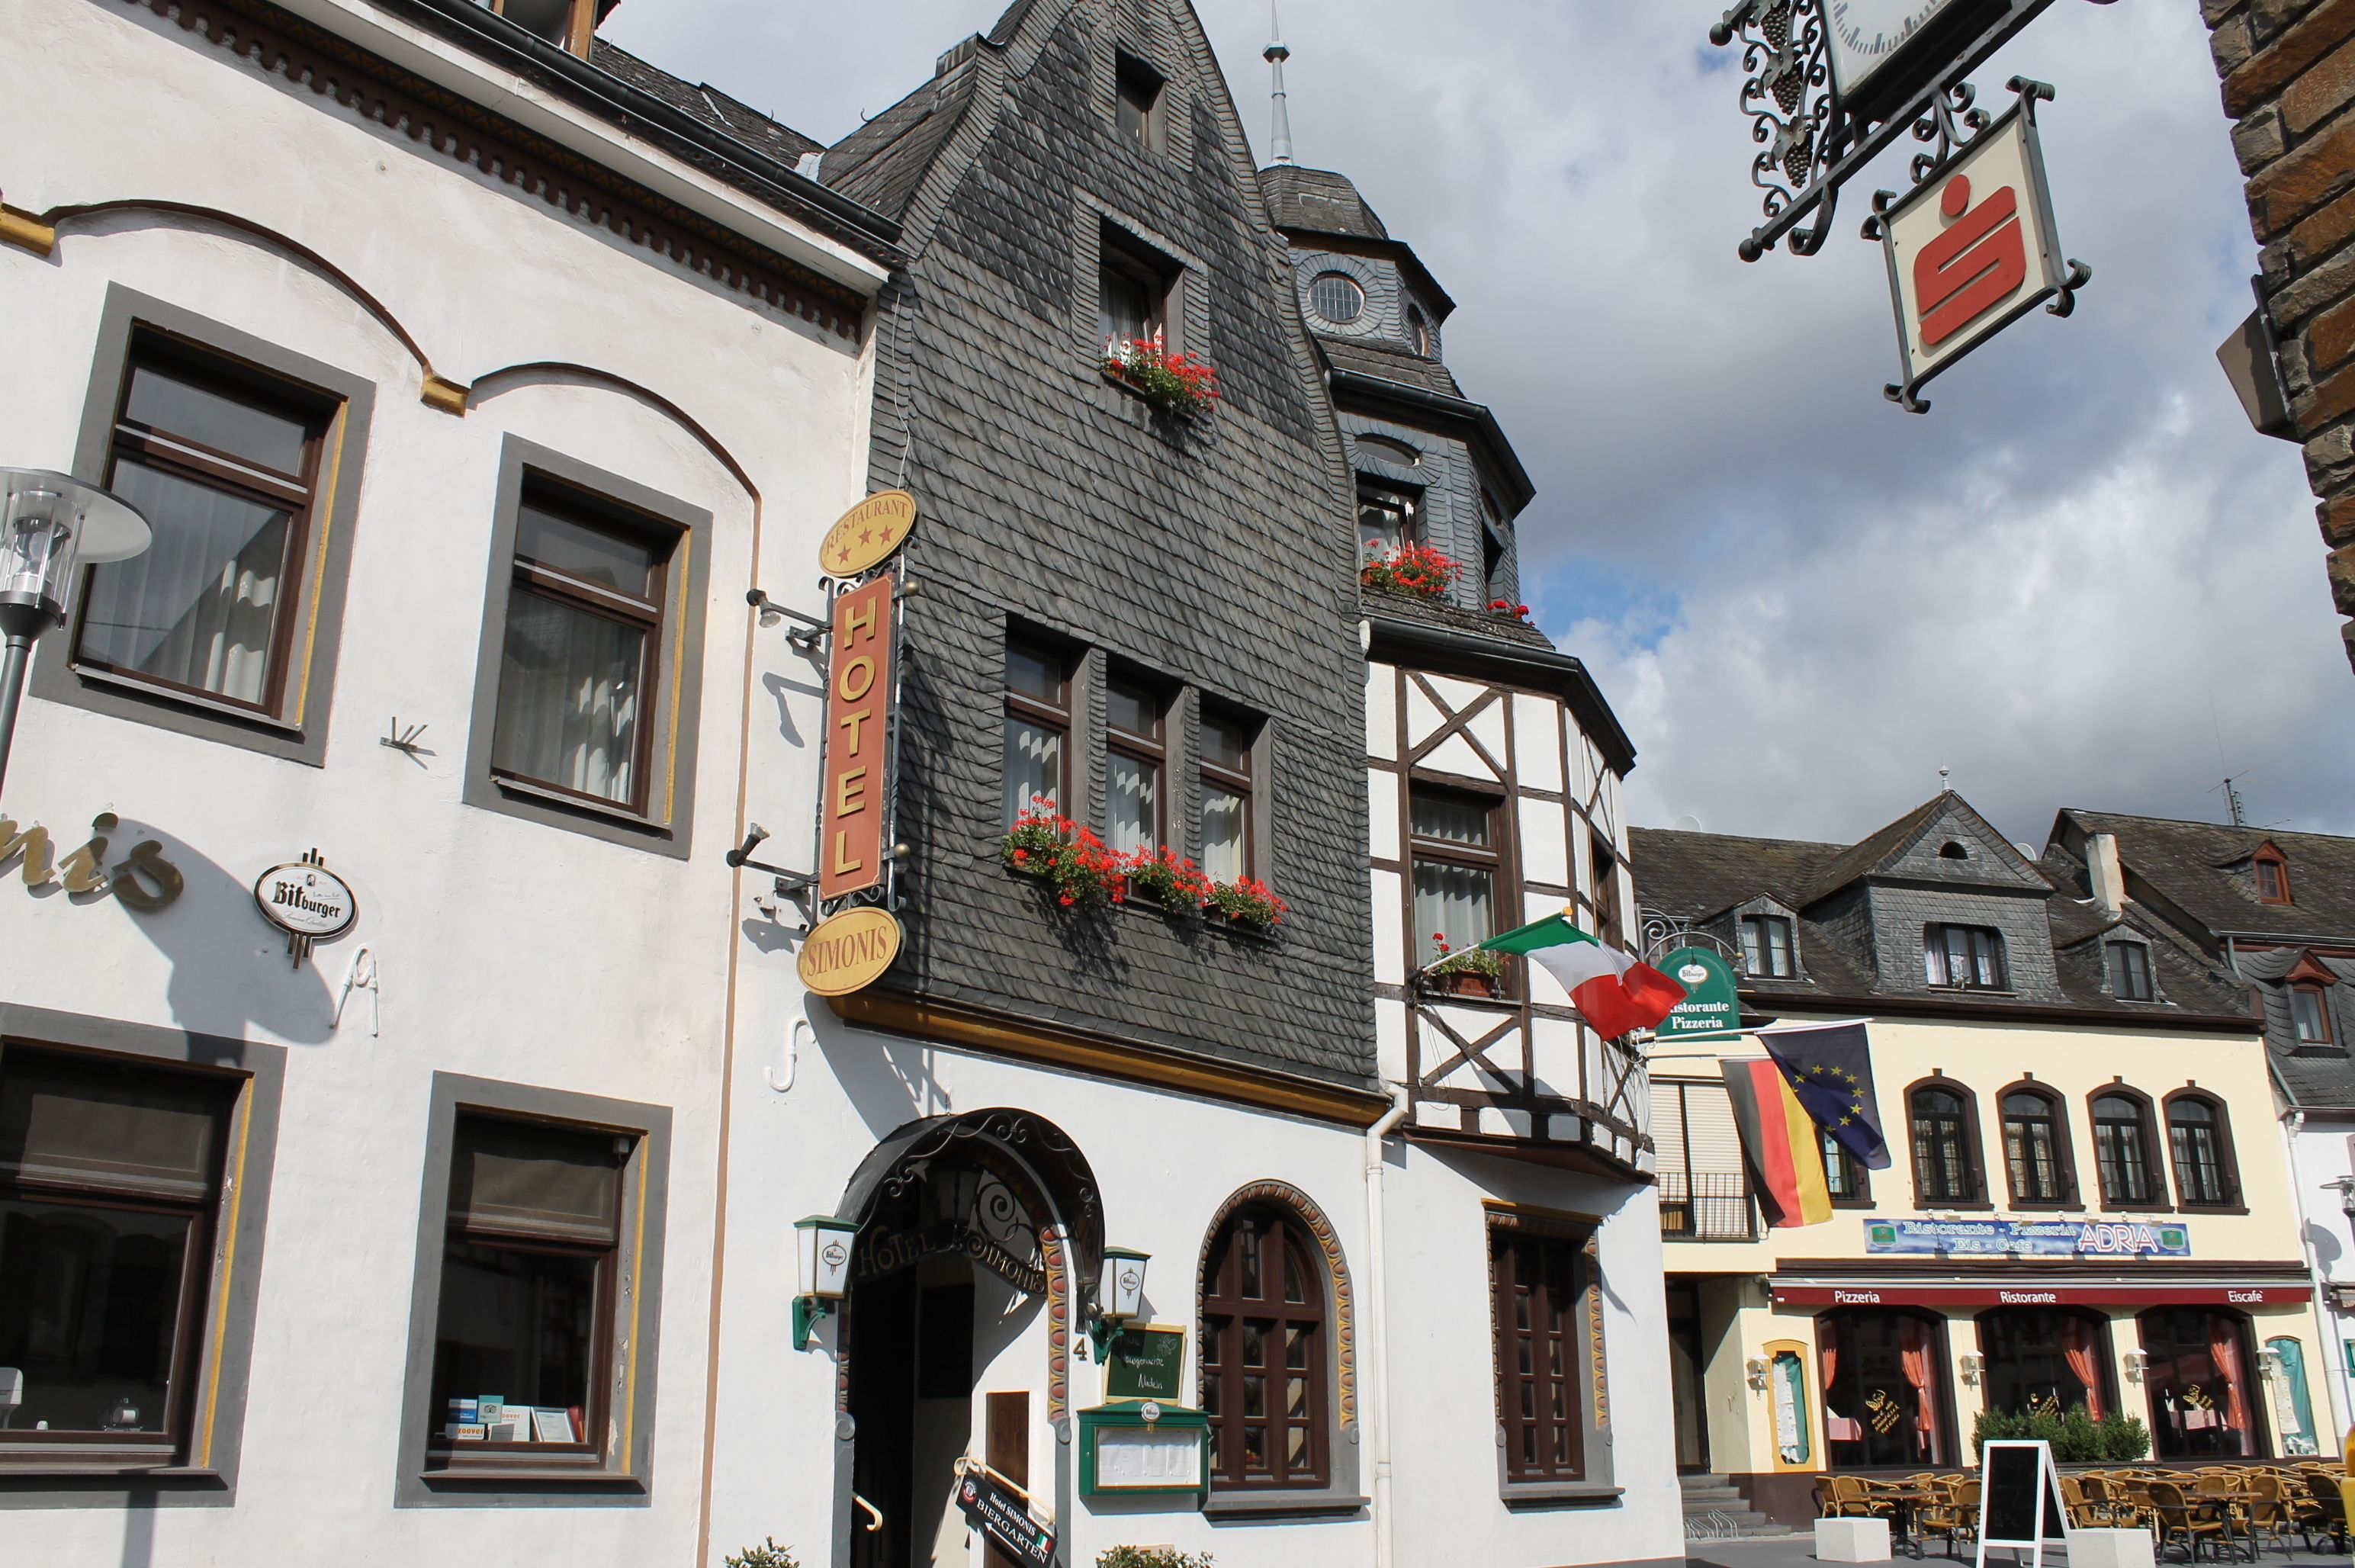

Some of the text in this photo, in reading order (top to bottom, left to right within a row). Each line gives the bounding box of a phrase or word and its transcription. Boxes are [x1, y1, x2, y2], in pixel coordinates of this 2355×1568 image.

[826, 500, 908, 555] RESTAURANT
[835, 596, 878, 876] HOTEL
[271, 881, 341, 918] Bitburger
[807, 925, 888, 977] SIMONIS
[1669, 1001, 1730, 1014] istorante
[1671, 1016, 1724, 1030] Pizzeria
[1903, 1221, 1995, 1235] Ristorante
[2009, 1223, 2077, 1236] Pizzeria
[2078, 1224, 2158, 1253] ADRIA
[857, 1224, 937, 1277] HOTEL
[1953, 1239, 1981, 1252] Eis
[1997, 1239, 2033, 1253] Cafe
[966, 1235, 1046, 1294] SIMONIS
[1834, 1290, 1881, 1303] Pizzeria
[2000, 1291, 2057, 1303] Ristorante
[1073, 1337, 1088, 1361] 4
[989, 1492, 1036, 1537] Hotel SIMONIS
[977, 1499, 1047, 1564] BIERGARTEN
